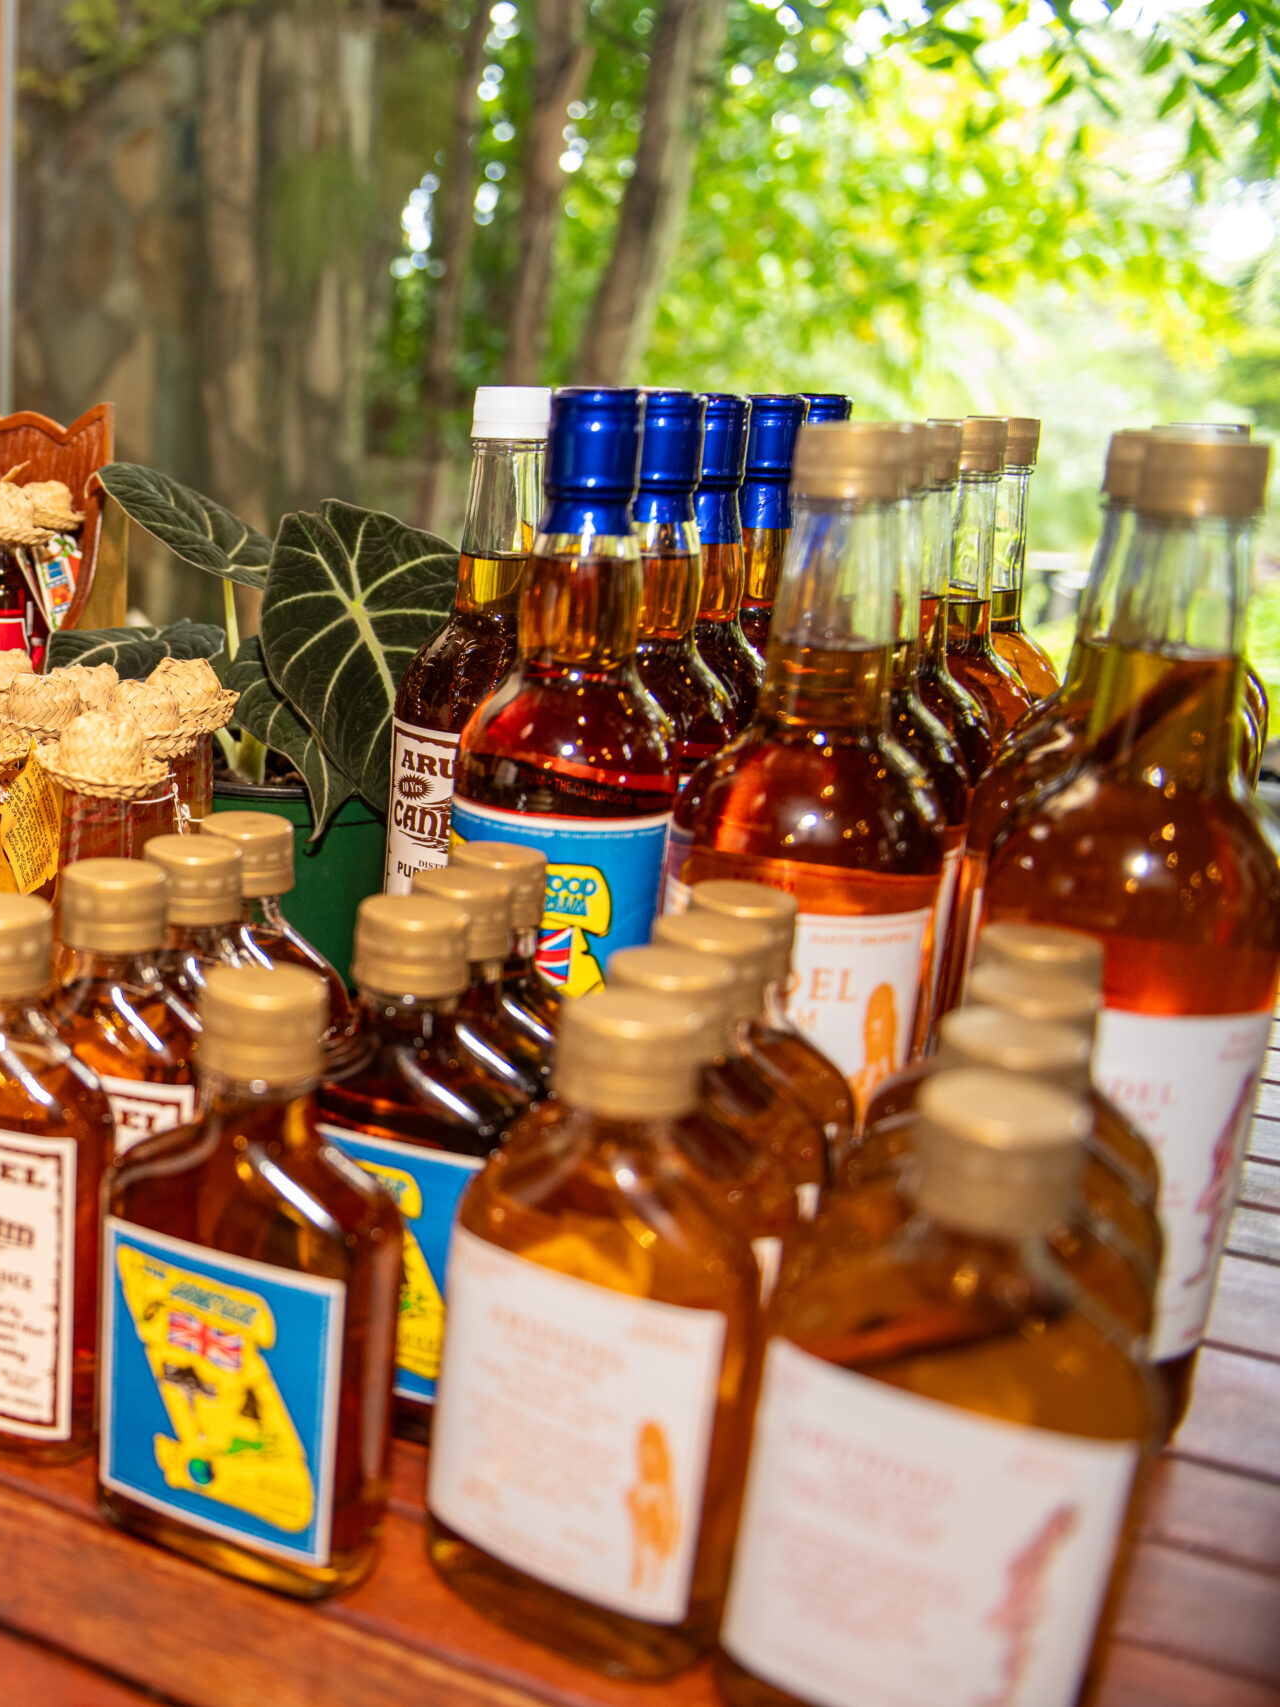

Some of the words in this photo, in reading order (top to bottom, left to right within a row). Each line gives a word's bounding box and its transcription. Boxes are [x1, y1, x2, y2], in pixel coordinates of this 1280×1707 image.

[402, 782, 409, 792] 10
[410, 781, 423, 793] Yrs
[546, 874, 598, 898] OOD
